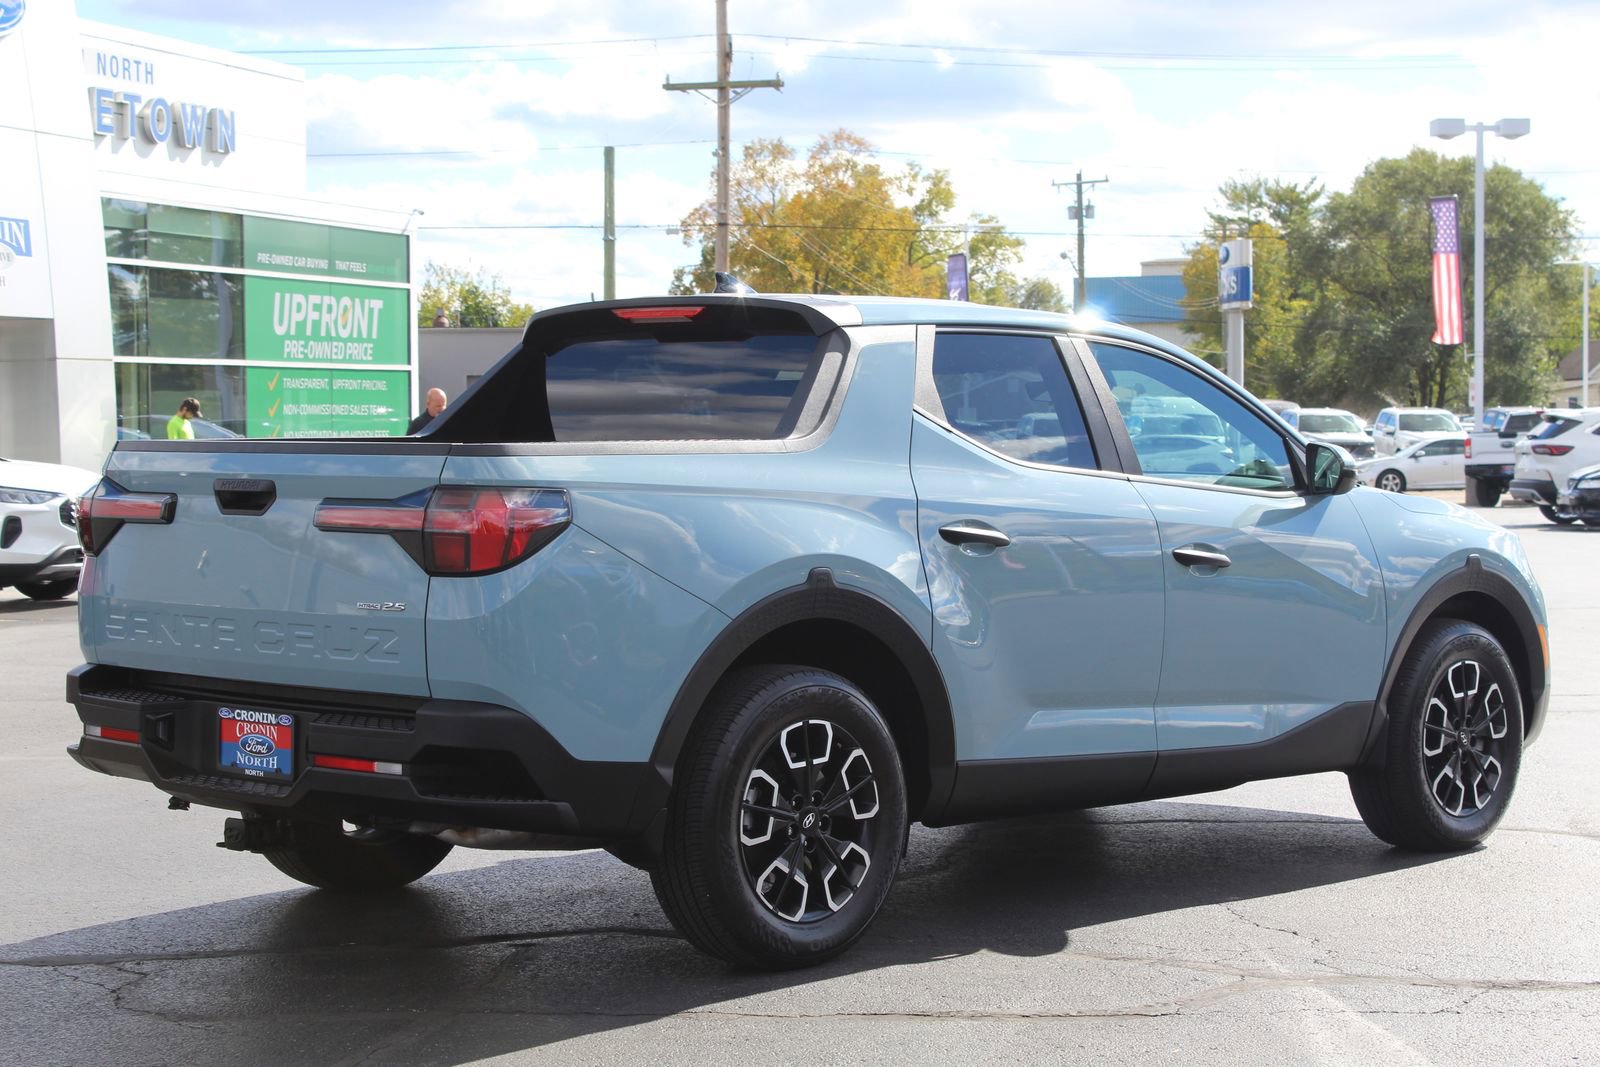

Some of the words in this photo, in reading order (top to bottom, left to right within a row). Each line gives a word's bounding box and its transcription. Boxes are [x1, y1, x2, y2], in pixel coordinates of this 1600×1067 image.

[97, 52, 154, 85] NORTH
[90, 87, 236, 153] ETOWN
[257, 252, 293, 267] PRE-OWNED
[294, 256, 305, 268] CAR
[306, 258, 329, 270] BUYING
[335, 260, 349, 271] THAT
[350, 262, 367, 273] FEELS
[273, 292, 384, 339] UPFRONT
[283, 340, 345, 359] PRE-OWNED
[346, 342, 374, 360] PRICE
[332, 379, 360, 390] UPFRONT
[283, 404, 348, 416] NON-COMMISSIONED
[349, 404, 368, 416] SALES
[105, 611, 242, 652] SANTA
[253, 620, 401, 664] CRUZ
[235, 709, 277, 724] CRONIN
[236, 721, 278, 741] CRONIN
[245, 737, 268, 753] Ford
[236, 750, 278, 769] NORTH
[245, 769, 264, 777] NORTH
